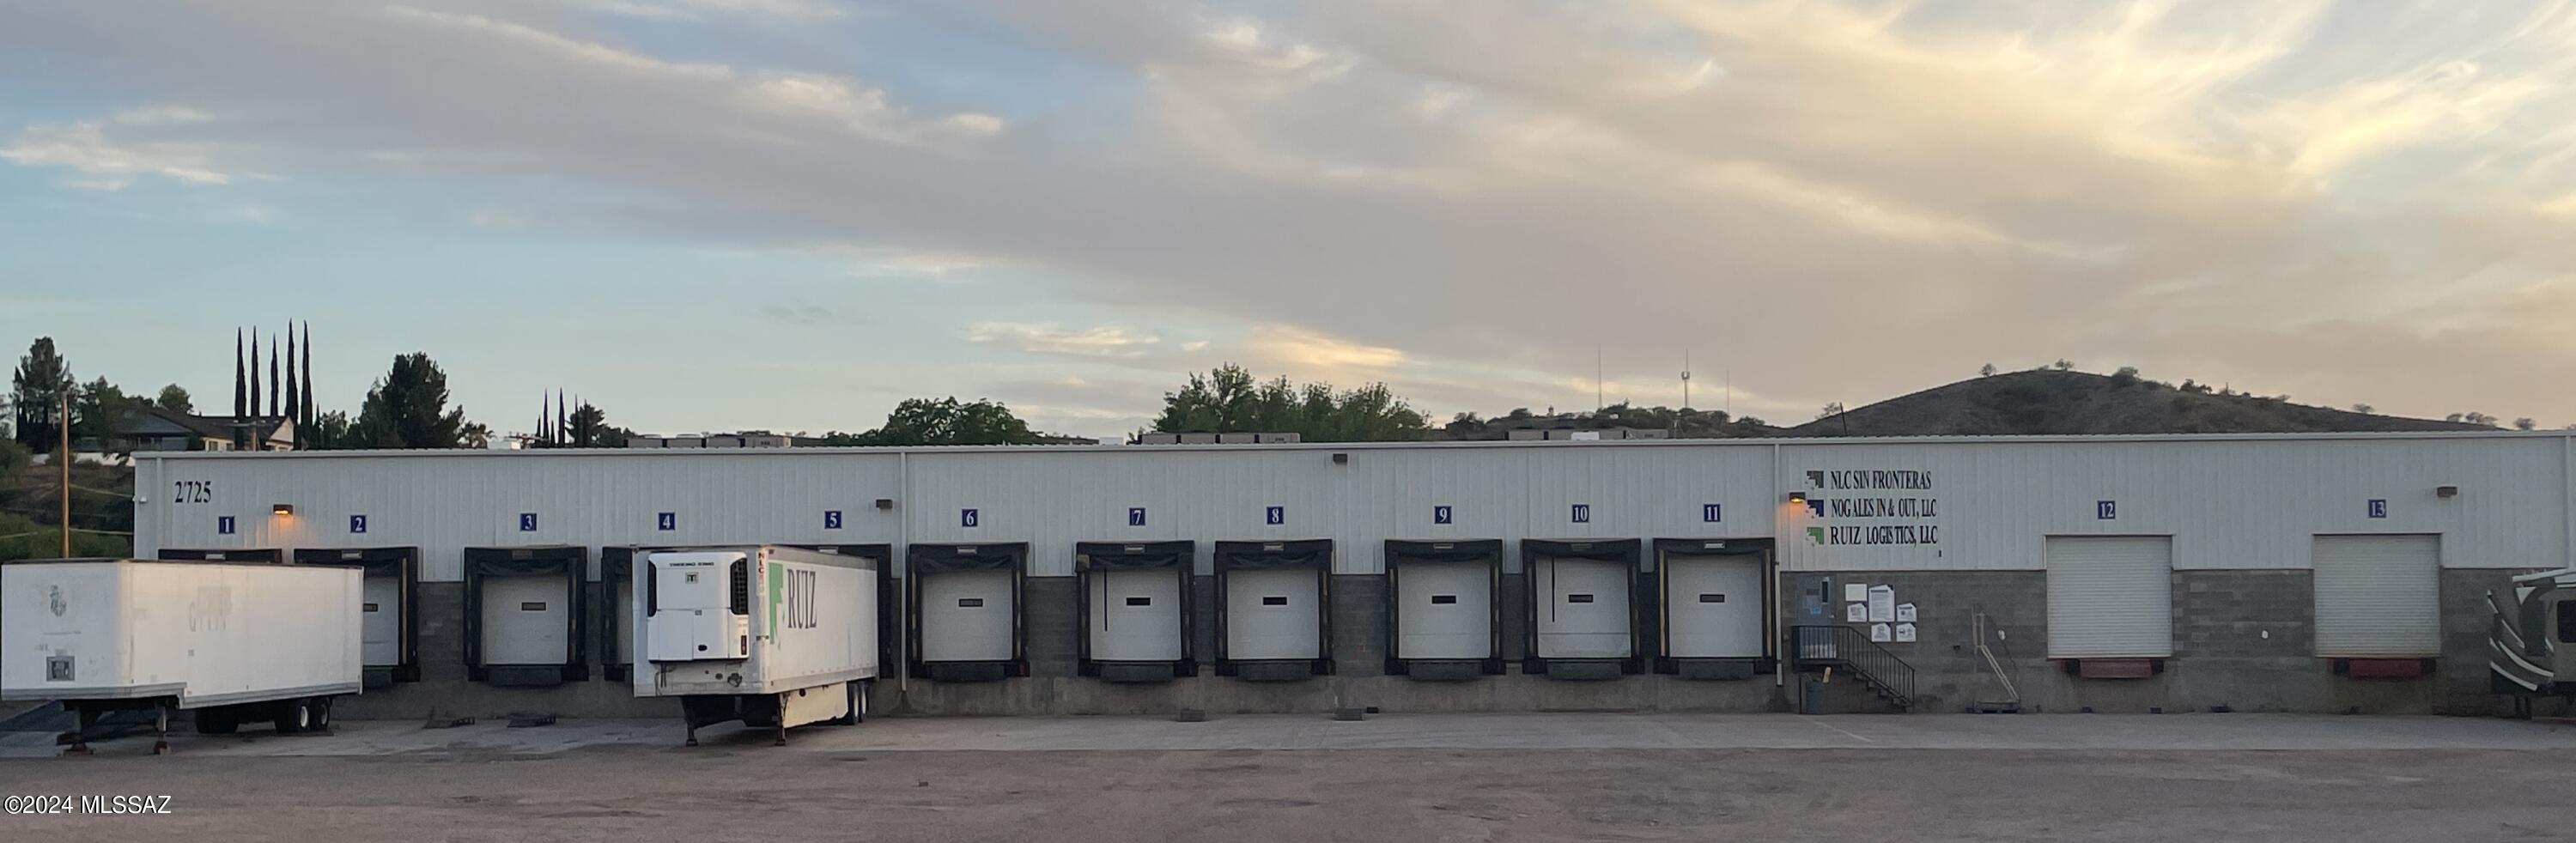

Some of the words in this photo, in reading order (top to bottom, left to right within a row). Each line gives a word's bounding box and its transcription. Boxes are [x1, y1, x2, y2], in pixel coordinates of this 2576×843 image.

[1831, 470, 1851, 489] NLC
[1853, 470, 1869, 489] SIN
[1872, 470, 1932, 489] FRONTERAS
[174, 481, 212, 503] 2725
[1272, 508, 1279, 523] 8
[1439, 508, 1447, 522] 9
[1575, 506, 1588, 521] 10
[1707, 506, 1718, 520] 11
[1831, 499, 1874, 518] NOGALES
[1876, 499, 1886, 517] IN
[1888, 500, 1895, 517] &
[1899, 499, 1919, 519] OUT,
[1921, 499, 1937, 517] LLC
[2100, 503, 2113, 518] 12
[2372, 501, 2385, 516] 13
[355, 517, 362, 531] 2
[525, 515, 532, 530] 3
[663, 514, 671, 529] 4
[829, 512, 837, 527] 5
[966, 511, 975, 525] 6
[1133, 510, 1141, 525] 7
[225, 518, 230, 533] 1
[1830, 526, 1862, 545] RUIZ
[1866, 526, 1916, 548] LOGISTICS,
[1919, 526, 1938, 544] LLC
[787, 569, 817, 629] RUIZ
